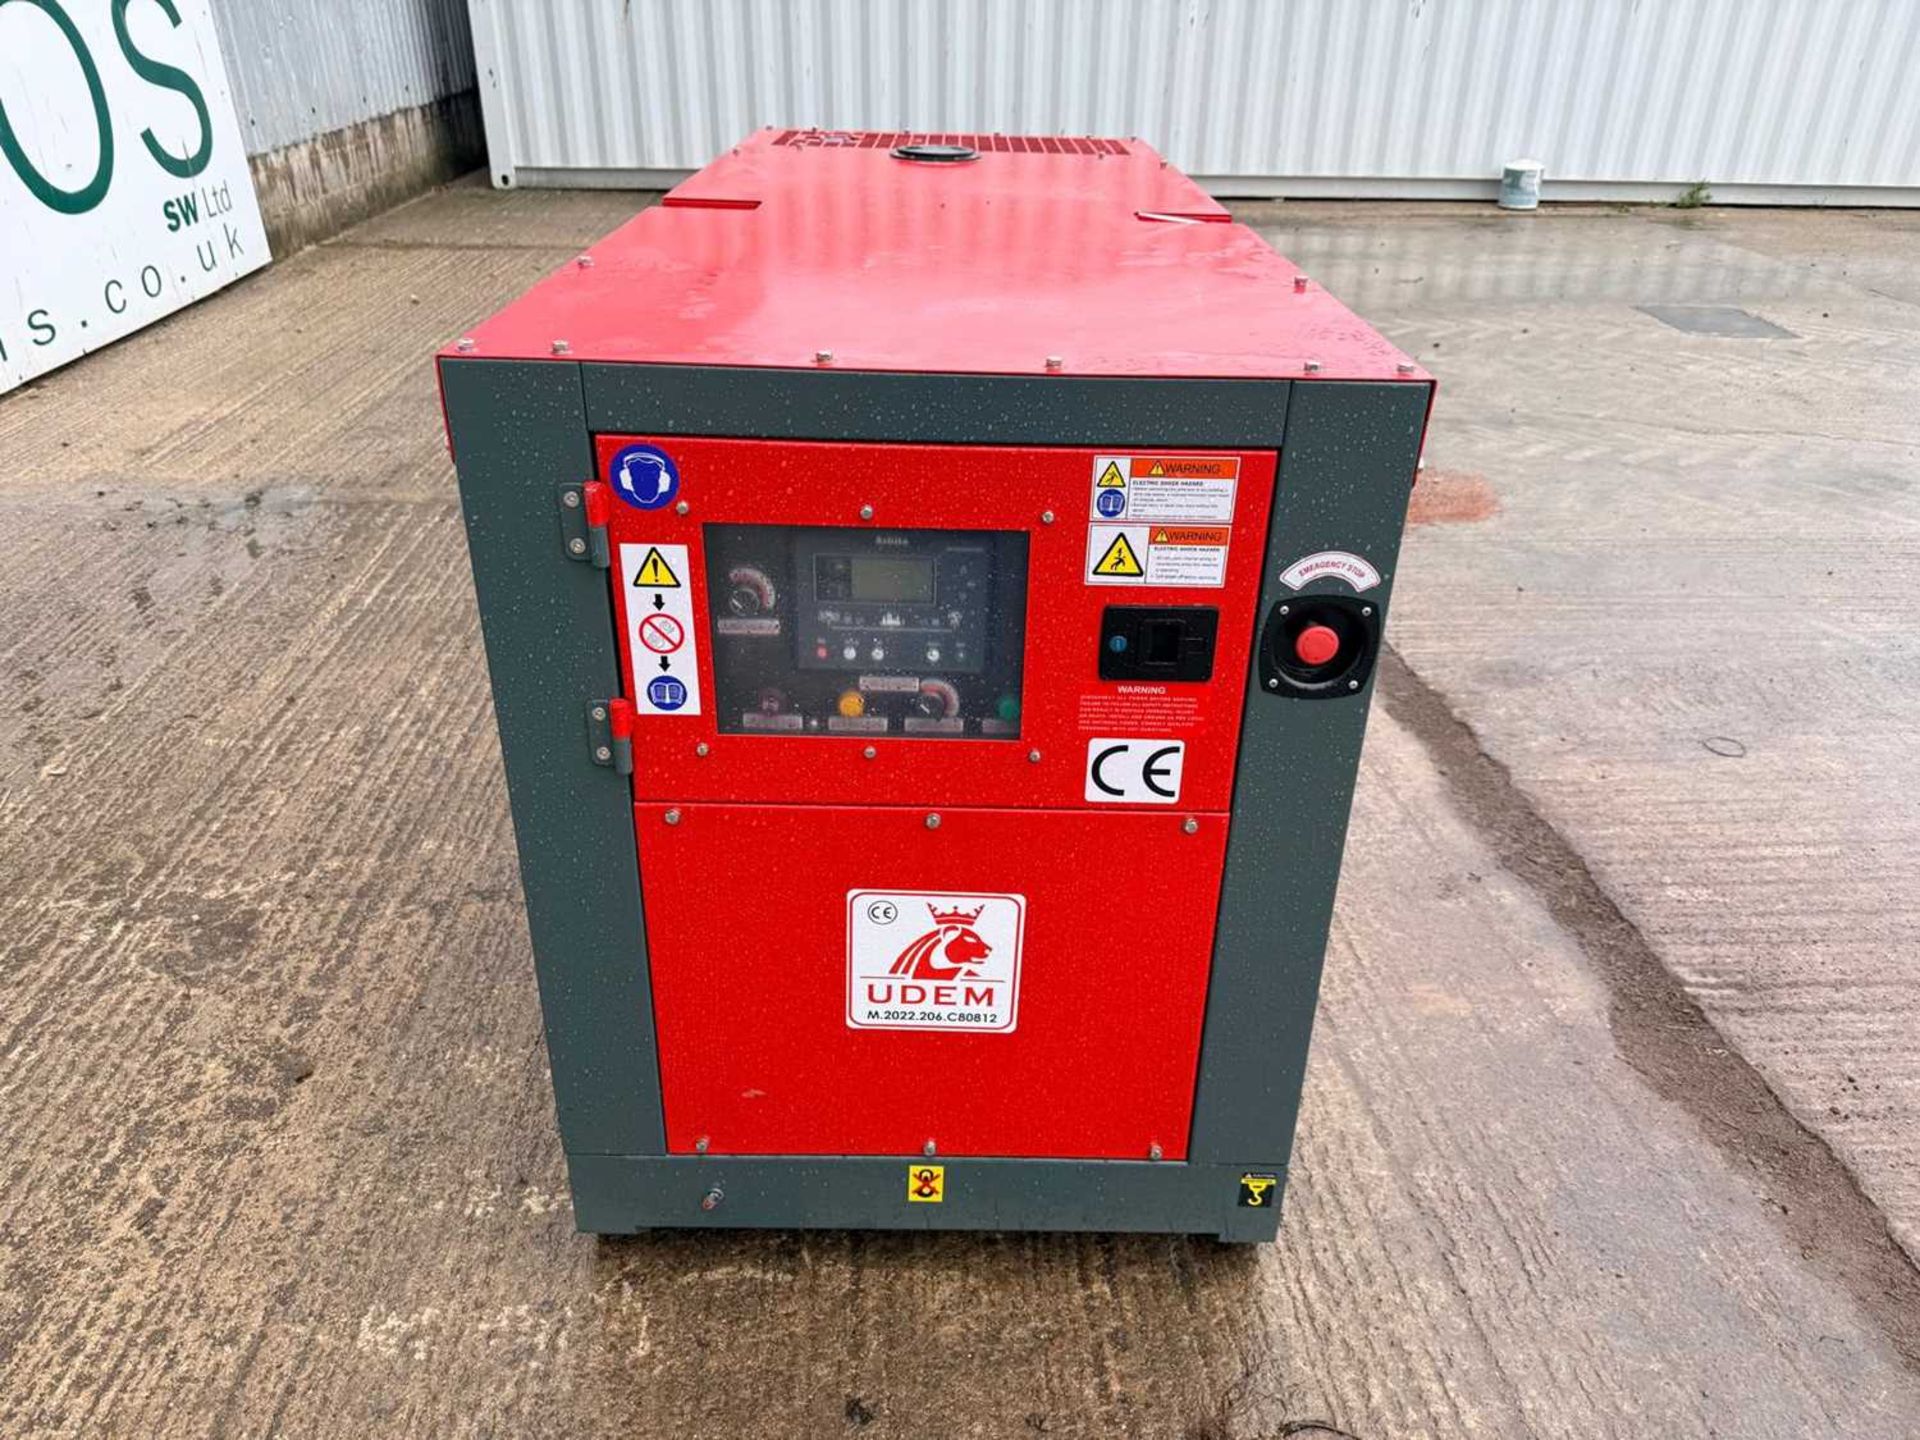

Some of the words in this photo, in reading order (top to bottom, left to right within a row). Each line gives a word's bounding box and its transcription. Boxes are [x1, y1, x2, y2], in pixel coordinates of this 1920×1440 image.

[163, 194, 200, 232] SW
[202, 181, 233, 219] Ltd
[0, 224, 245, 362] s.co.uk
[1166, 463, 1221, 474] WARNING
[1169, 531, 1222, 541] WARNING
[1298, 560, 1347, 577] EMERGENCY
[1346, 563, 1367, 579] STOP
[1117, 685, 1167, 695] WARNING
[1091, 744, 1180, 797] CE
[871, 905, 893, 920] CE
[867, 983, 995, 1007] UDEM
[867, 1010, 998, 1023] M.2022.206.C80812
